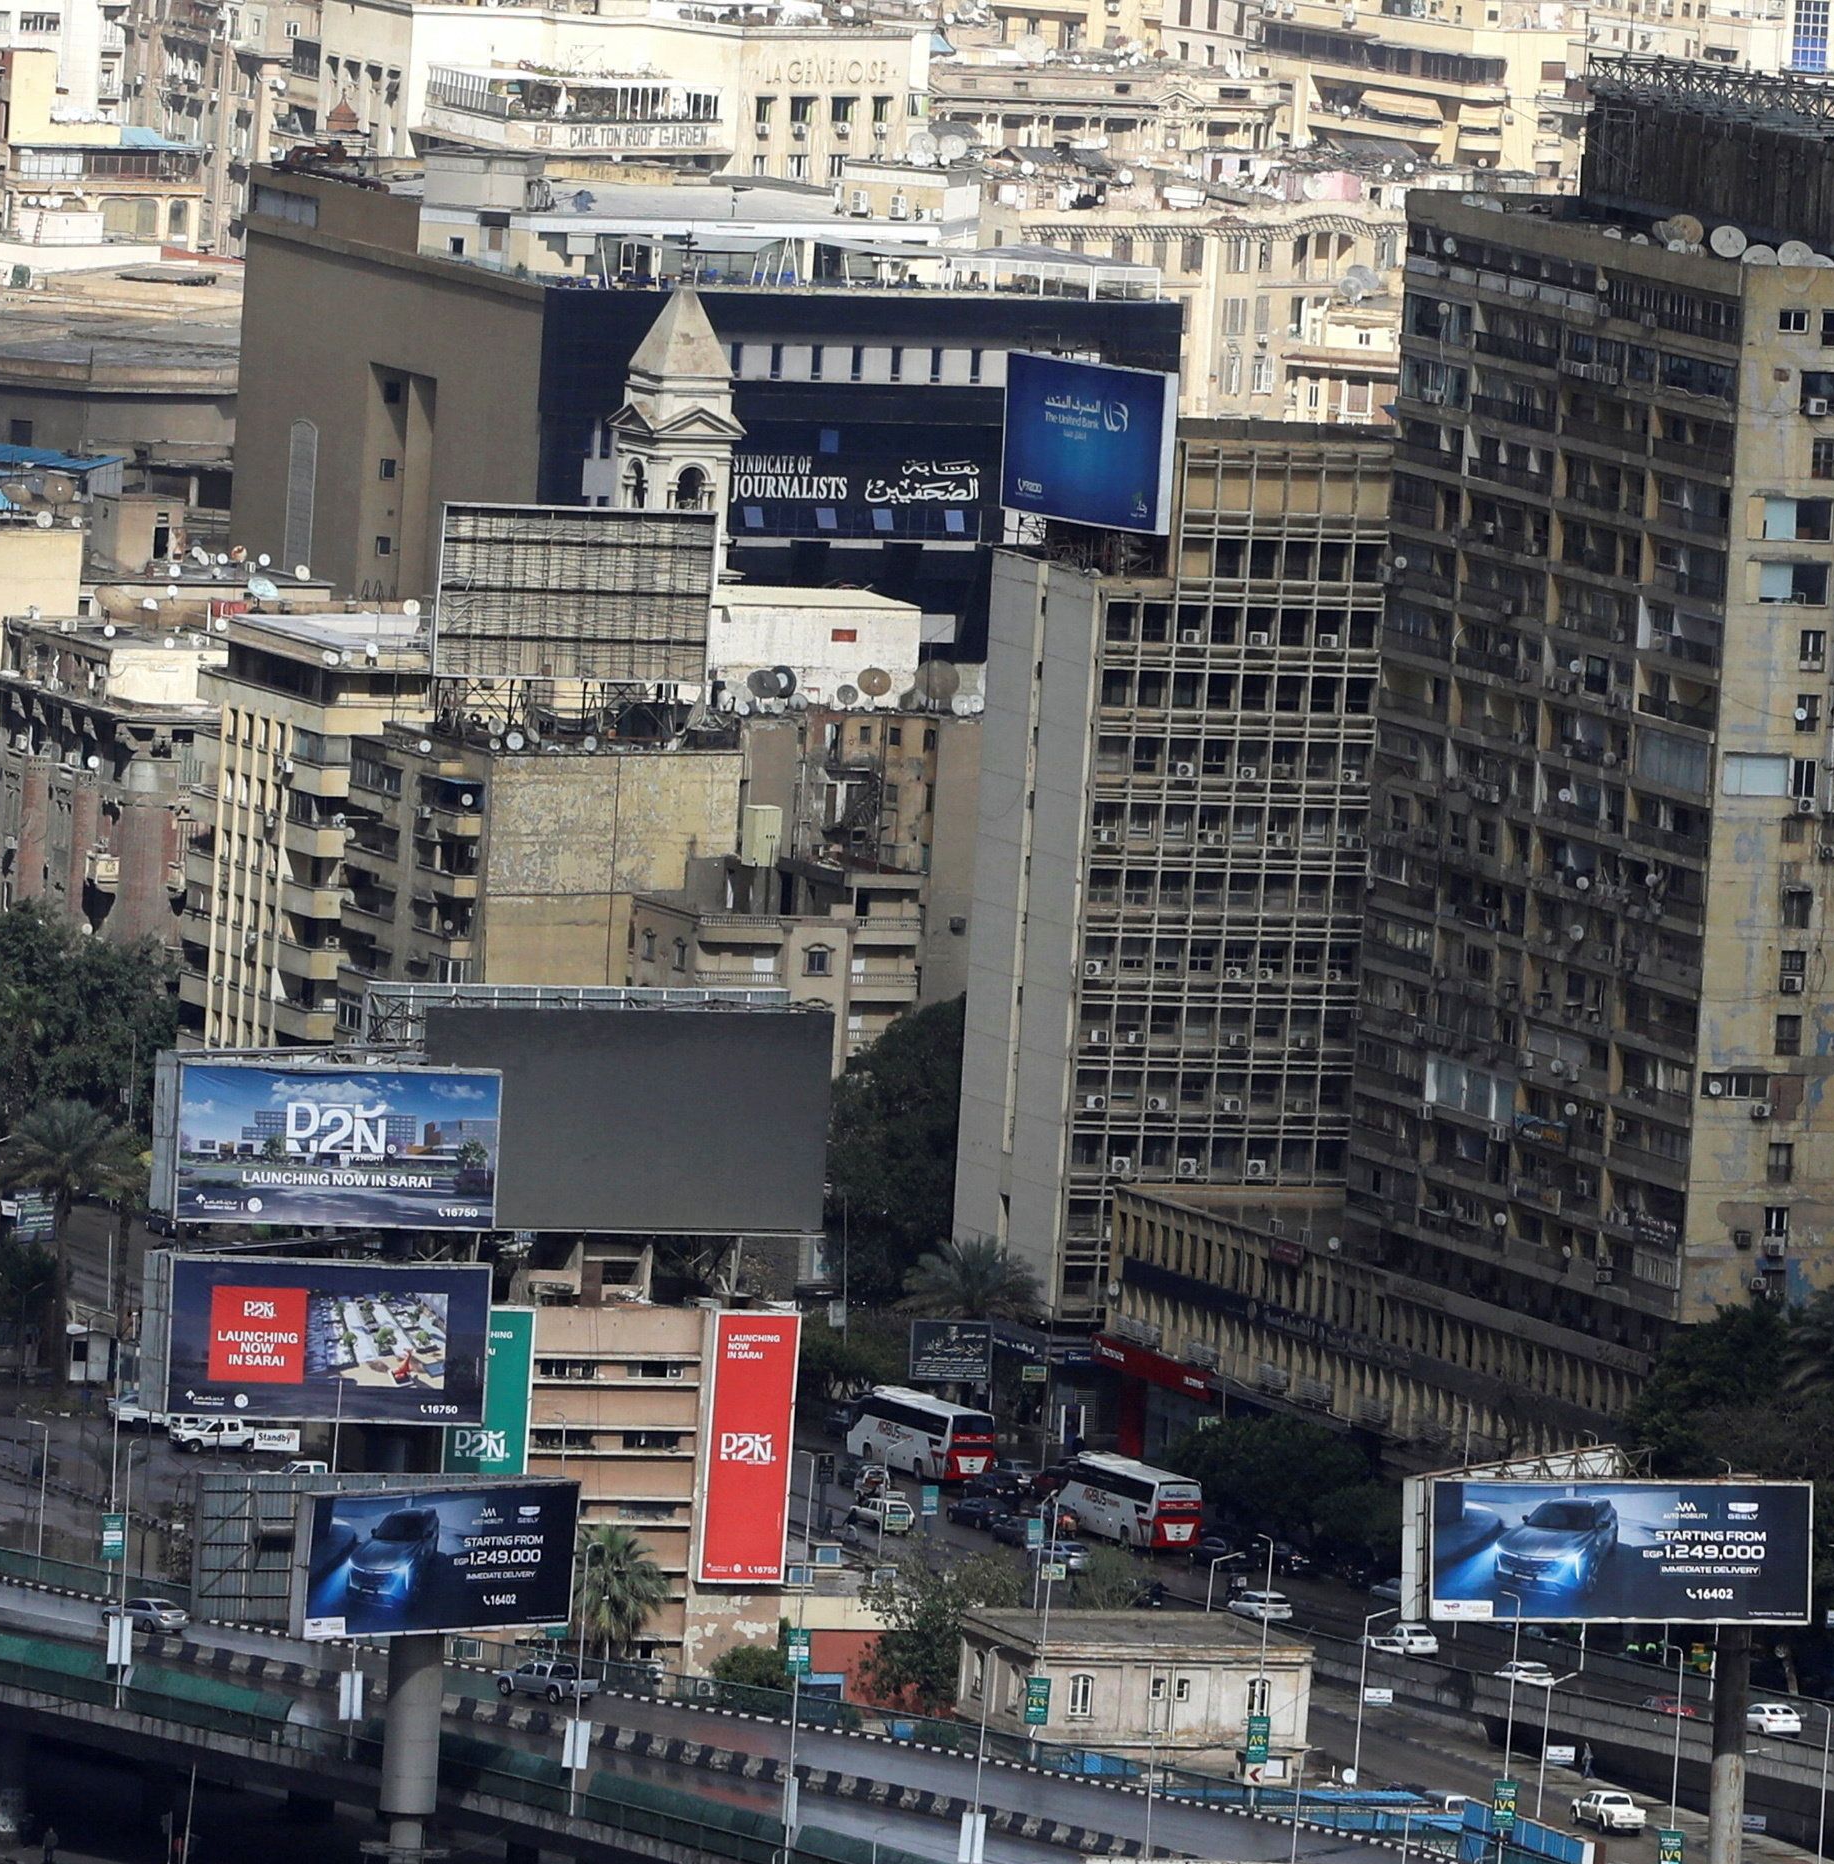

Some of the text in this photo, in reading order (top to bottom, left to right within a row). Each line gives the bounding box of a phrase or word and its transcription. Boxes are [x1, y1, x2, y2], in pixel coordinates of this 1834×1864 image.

[569, 124, 708, 148] CARLTON ROOF GARDEN
[733, 455, 812, 475] SYNDICATE OF
[731, 476, 848, 503] JOURNALISTS
[242, 1170, 432, 1189] LAUNCHING NOW IN SARAI
[444, 1207, 478, 1218] 16750
[217, 1330, 298, 1345] LAUNCHING
[728, 1333, 781, 1343] LAUNCHING
[240, 1342, 274, 1354] NOW
[727, 1342, 750, 1351] NOW
[228, 1354, 285, 1367] IN SARAI
[727, 1351, 763, 1360] IN SARAI
[427, 1404, 458, 1415] 16750
[257, 1432, 290, 1445] Standby
[463, 1534, 544, 1548] STARTING FROM
[1655, 1530, 1767, 1543] STARTING FROM
[453, 1549, 541, 1567] EGP 1,249,000
[1642, 1544, 1765, 1561] EGP 1,249,000
[466, 1570, 536, 1580] IMMEDIATE DELIVERY
[753, 1566, 778, 1575] 16750
[1661, 1565, 1760, 1575] IMMEDIATE DELIVERY
[490, 1593, 517, 1605] 16402
[1696, 1587, 1734, 1600] 16402
